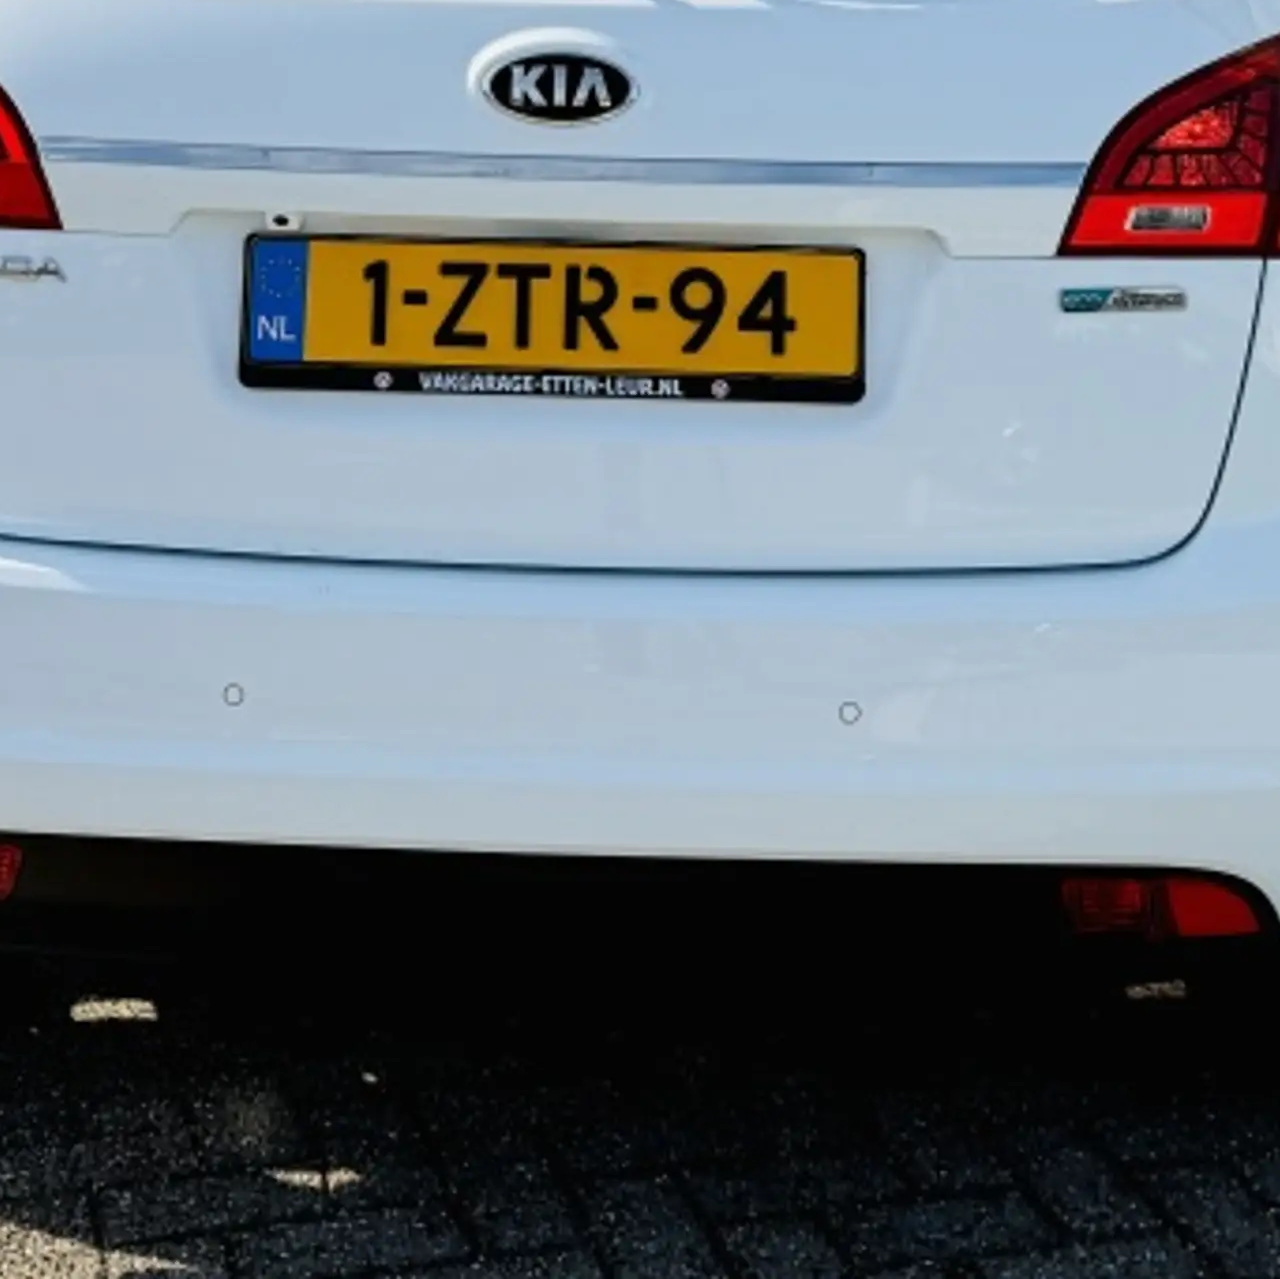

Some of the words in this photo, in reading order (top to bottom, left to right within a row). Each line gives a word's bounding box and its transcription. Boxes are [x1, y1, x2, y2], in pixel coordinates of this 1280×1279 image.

[511, 64, 612, 107] KIA
[363, 259, 796, 357] 1-ZTR-94
[257, 315, 296, 341] NL
[419, 372, 685, 396] VAKGARAGE-ETTEN-LEUR.NL
